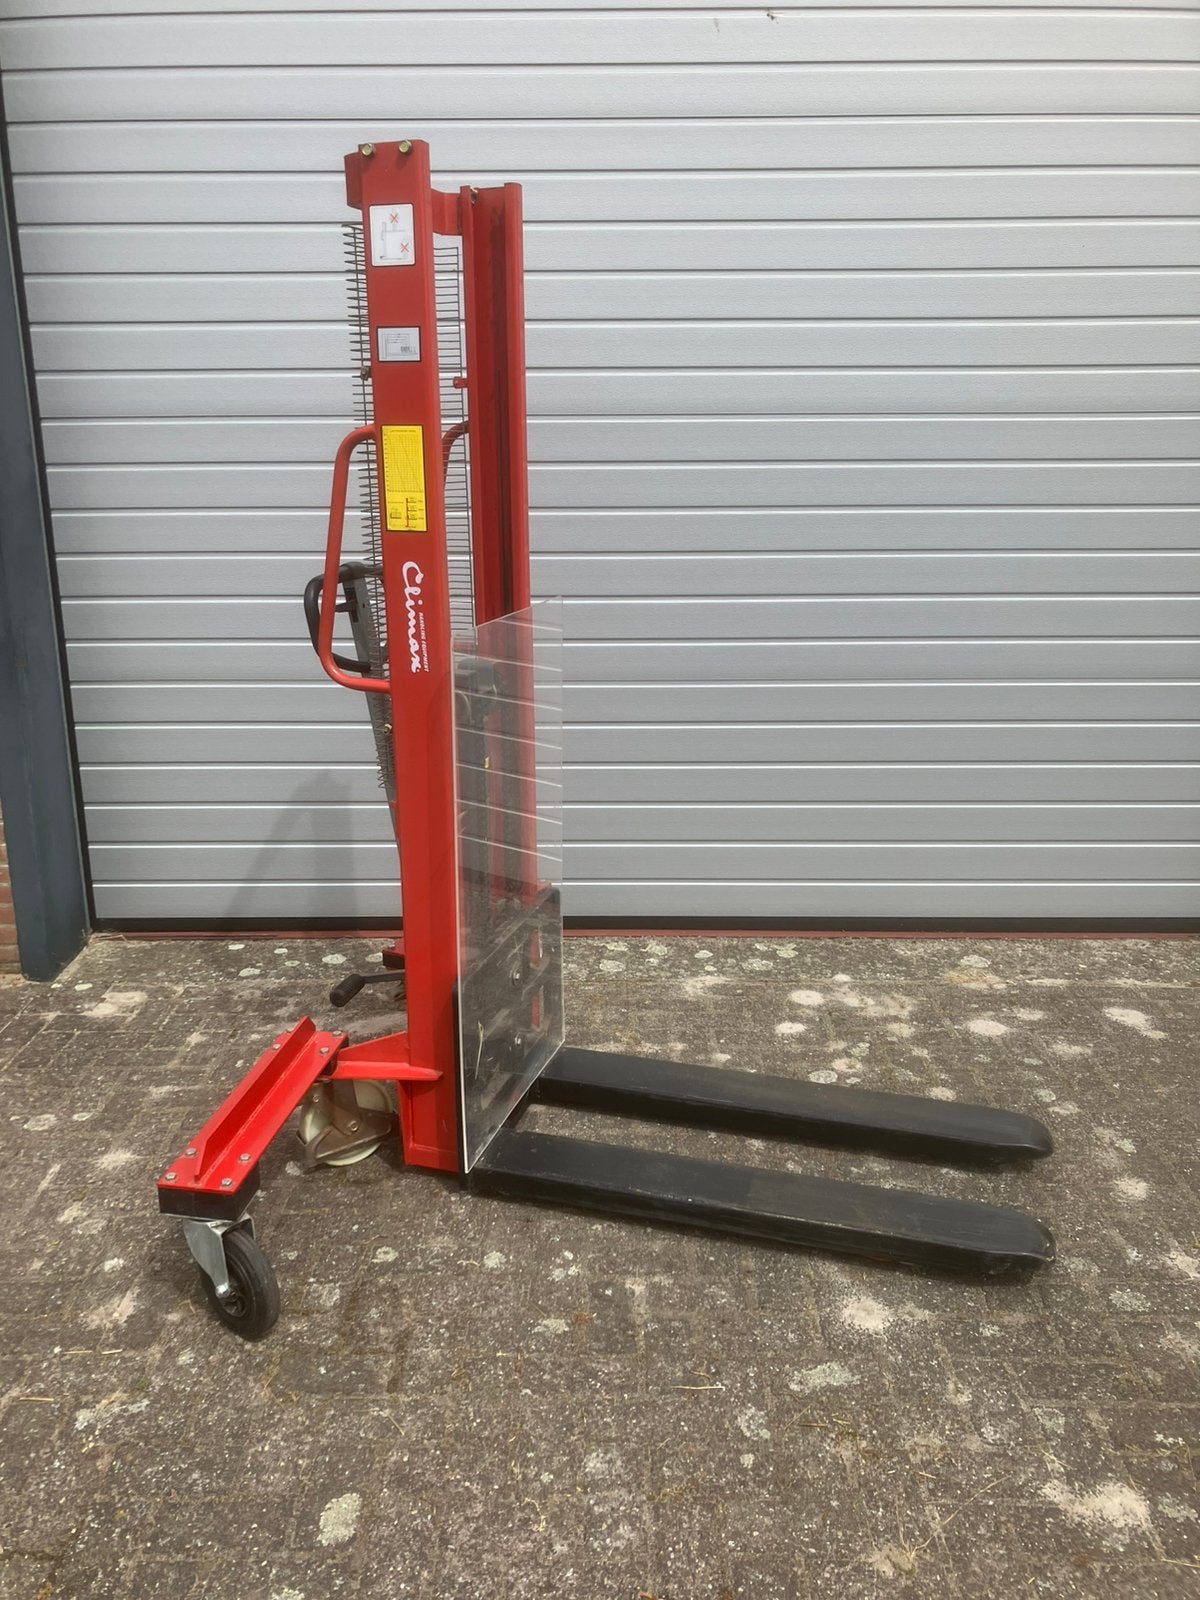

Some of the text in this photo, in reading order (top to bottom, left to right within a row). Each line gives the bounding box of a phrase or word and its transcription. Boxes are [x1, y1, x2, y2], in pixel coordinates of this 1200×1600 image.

[402, 561, 424, 673] Climax
[418, 612, 429, 672] HANDLING EQUIPMENT
